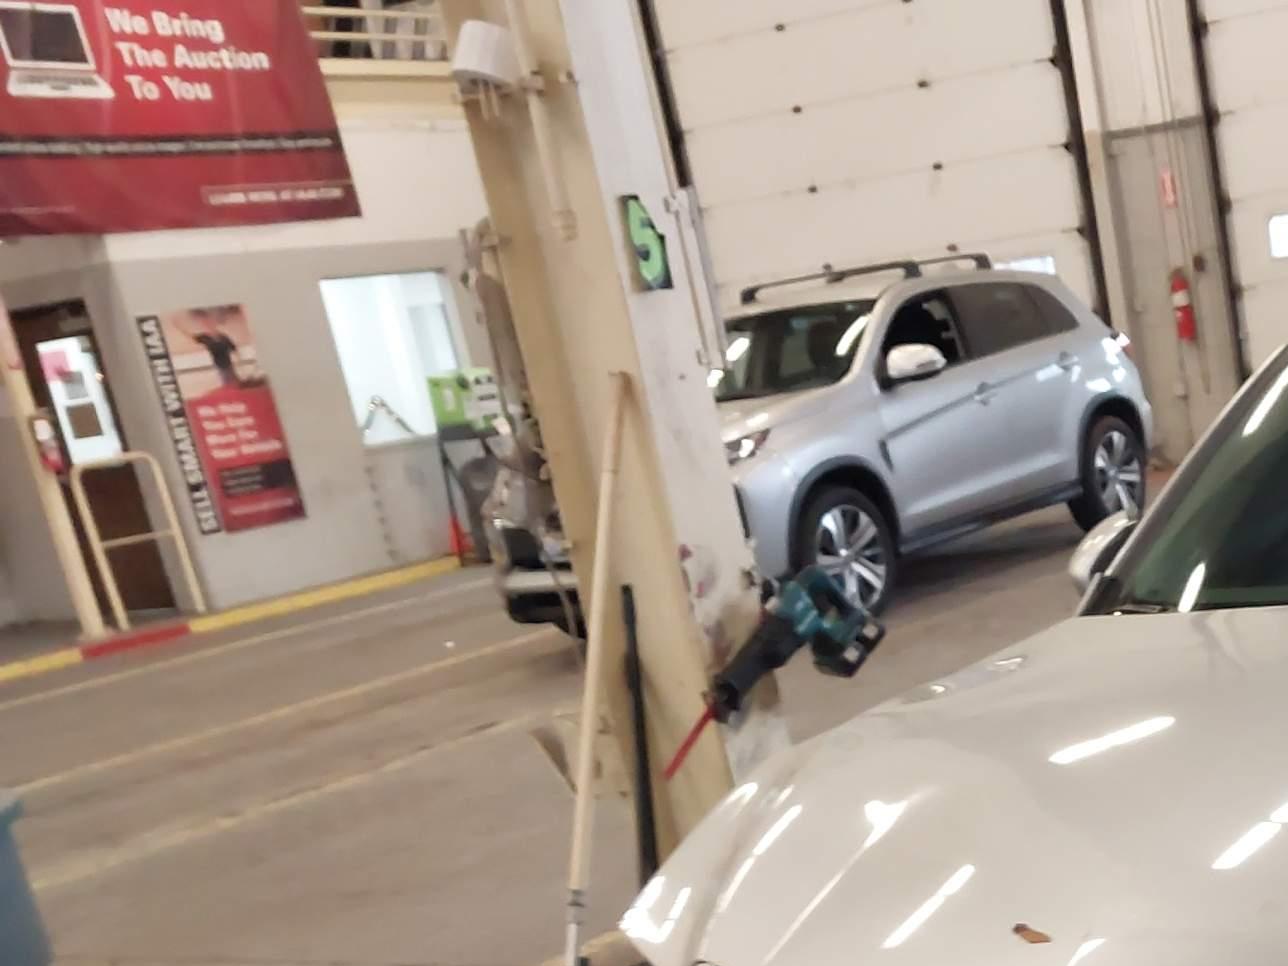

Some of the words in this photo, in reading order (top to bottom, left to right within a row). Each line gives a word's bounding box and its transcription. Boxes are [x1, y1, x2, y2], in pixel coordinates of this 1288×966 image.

[104, 8, 149, 34] We
[151, 11, 225, 43] Bring
[115, 42, 167, 67] The
[174, 44, 270, 70] Auction
[124, 75, 160, 100] To
[163, 76, 213, 100] You
